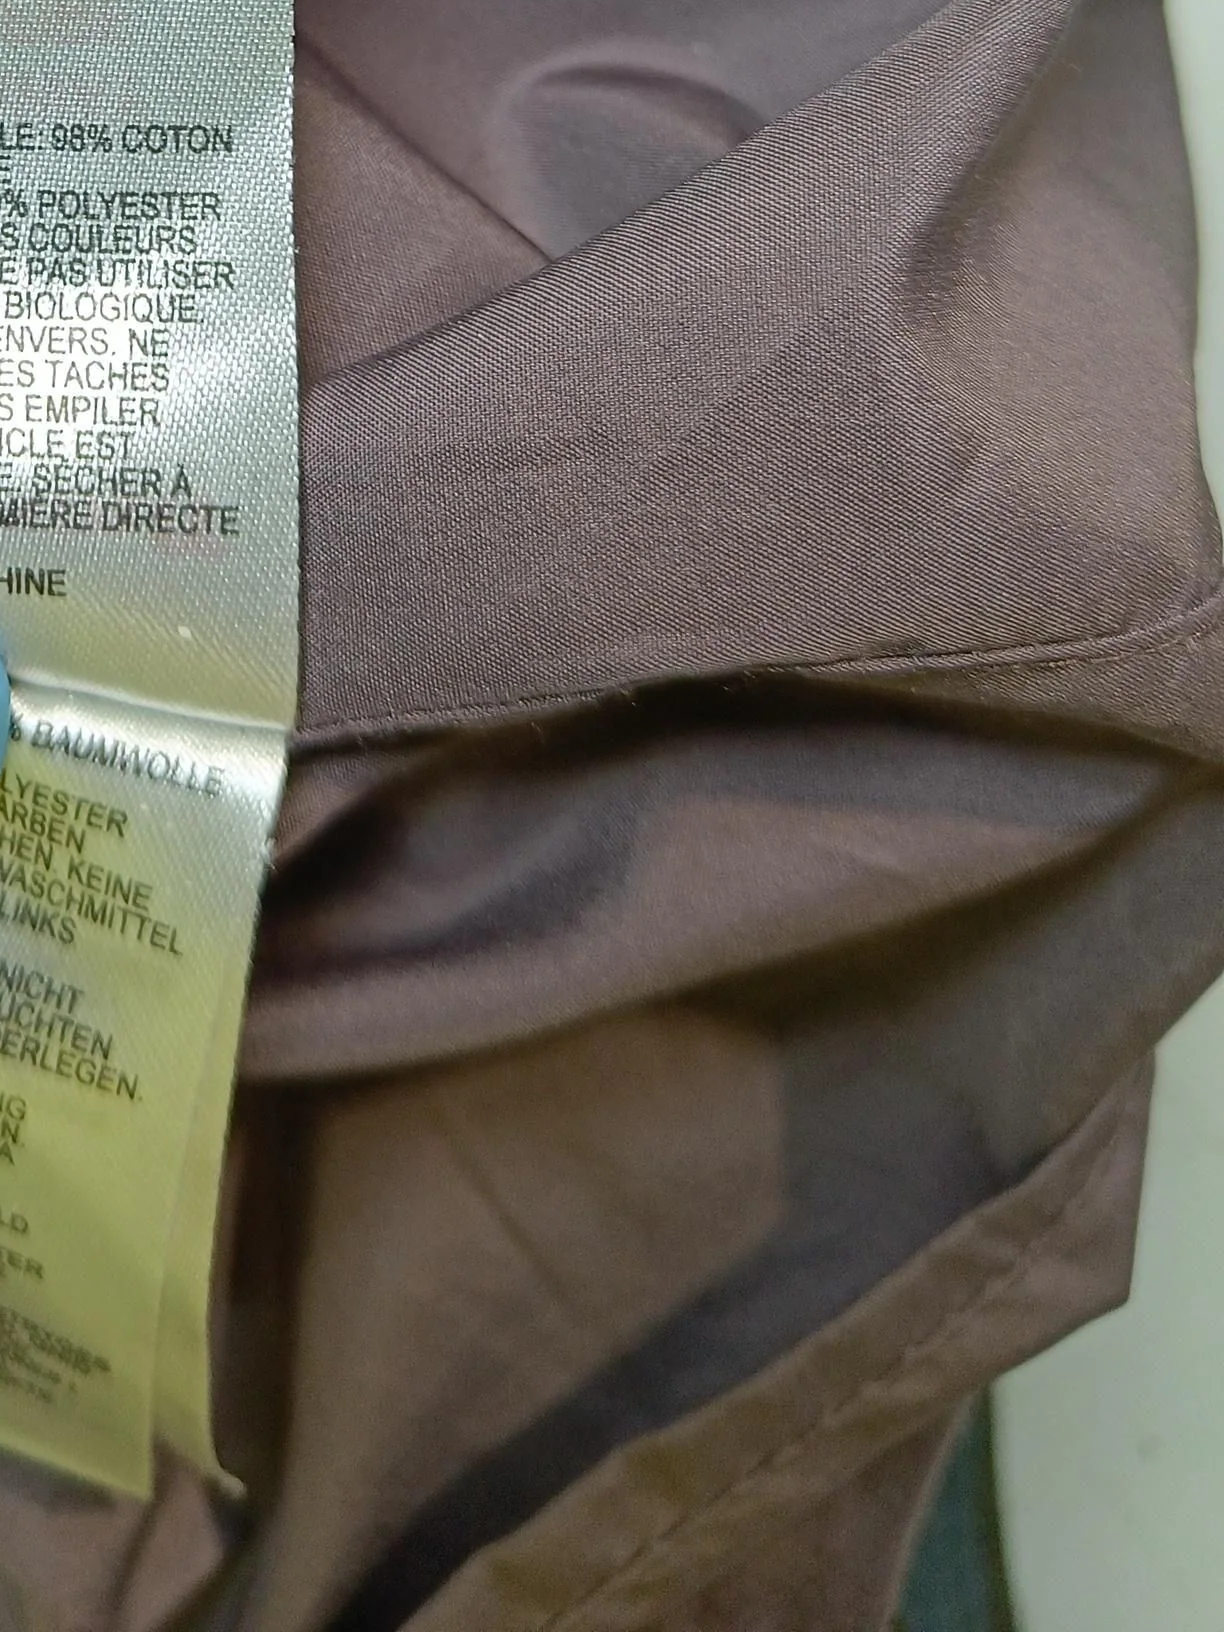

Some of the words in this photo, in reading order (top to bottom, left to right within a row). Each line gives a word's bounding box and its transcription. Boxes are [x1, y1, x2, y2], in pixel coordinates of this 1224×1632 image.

[52, 125, 112, 152] 98%
[123, 125, 232, 153] COTON
[38, 192, 222, 221] POLYESTER
[28, 224, 198, 255] COULEURS
[28, 259, 87, 287] PAS
[101, 262, 237, 290] UTILISER
[5, 289, 204, 324] BIOLOGIQUE.
[126, 329, 170, 357] NE
[44, 359, 170, 391] TACHES
[26, 395, 160, 427] EMPILER
[78, 431, 135, 460] EST
[101, 502, 240, 536] DIRECTE
[32, 719, 223, 797] BAUMWOLLE
[68, 858, 152, 913] KEINE
